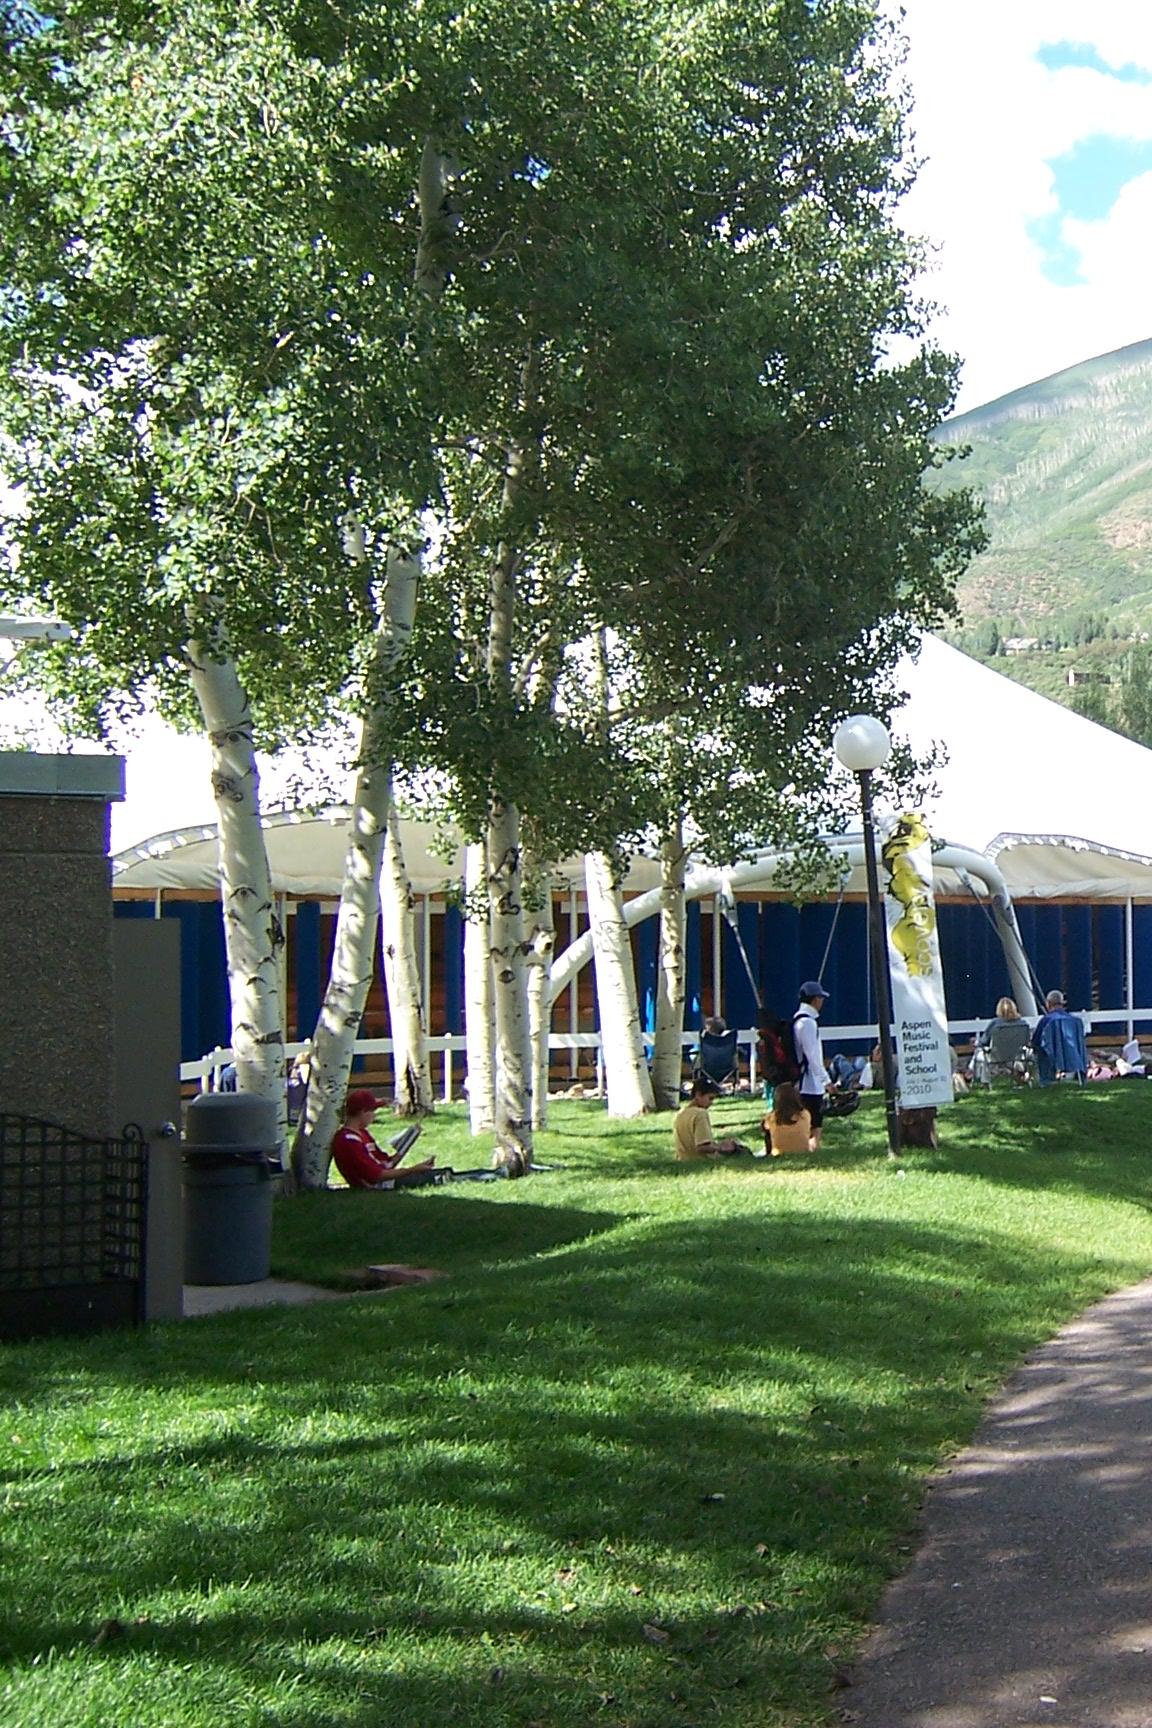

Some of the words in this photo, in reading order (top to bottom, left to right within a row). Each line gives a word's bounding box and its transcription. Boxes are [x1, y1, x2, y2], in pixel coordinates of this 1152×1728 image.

[901, 1021, 931, 1031] Aspen
[902, 1031, 931, 1041] Music
[903, 1042, 938, 1052] Festival
[904, 1054, 922, 1064] and
[905, 1064, 937, 1075] School
